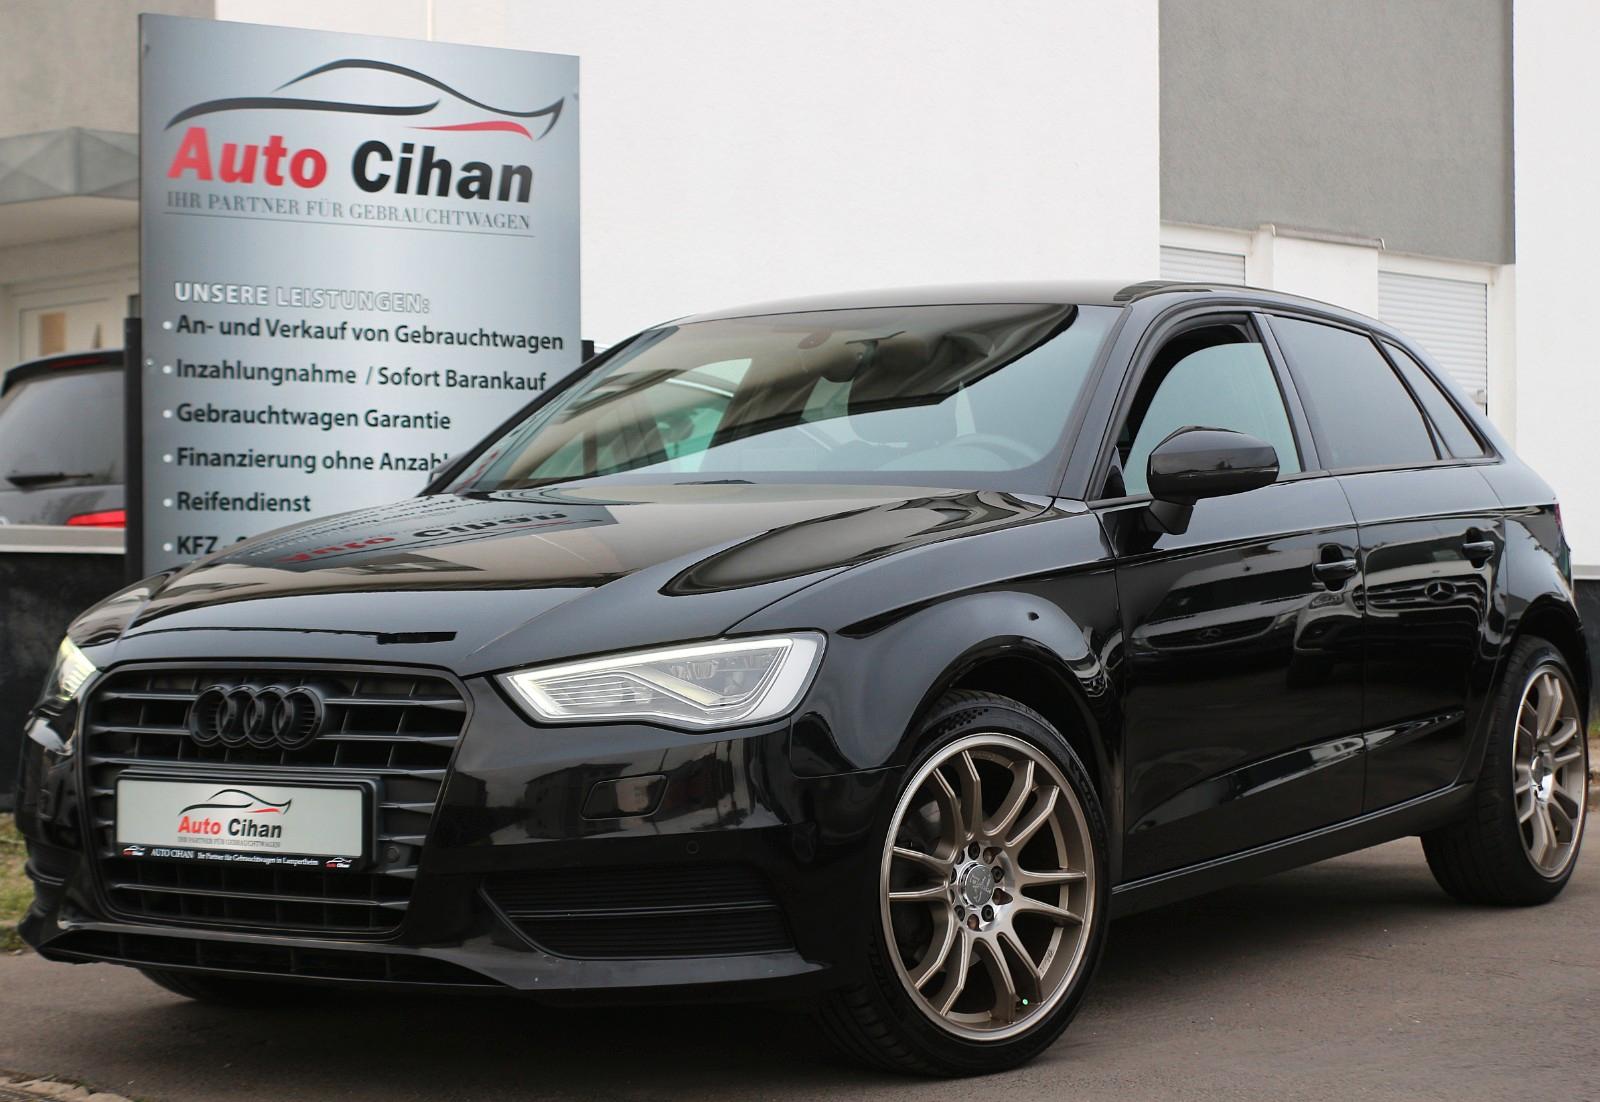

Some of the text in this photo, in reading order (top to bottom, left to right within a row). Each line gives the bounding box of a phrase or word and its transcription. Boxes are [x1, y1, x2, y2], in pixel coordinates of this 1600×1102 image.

[167, 126, 533, 203] Auto Cihan
[167, 190, 531, 231] IHR PARTNER FÜR GEBRAUCHTWAGEN
[174, 282, 431, 313] UNSERE LEISTUNGEN:
[176, 315, 565, 354] An- und Verkauf von Gebrauchtwagen
[176, 359, 547, 391] Inzahlungnahme / Sofort Barankauf
[176, 404, 452, 431] Gebrauchtwagen Garantie
[177, 447, 317, 473] Finanzierung
[322, 450, 374, 470] ohne
[177, 491, 312, 512] Reifendienst
[177, 535, 218, 555] KFZ
[177, 815, 282, 838] Auto Cihan
[151, 848, 170, 857] AUTO
